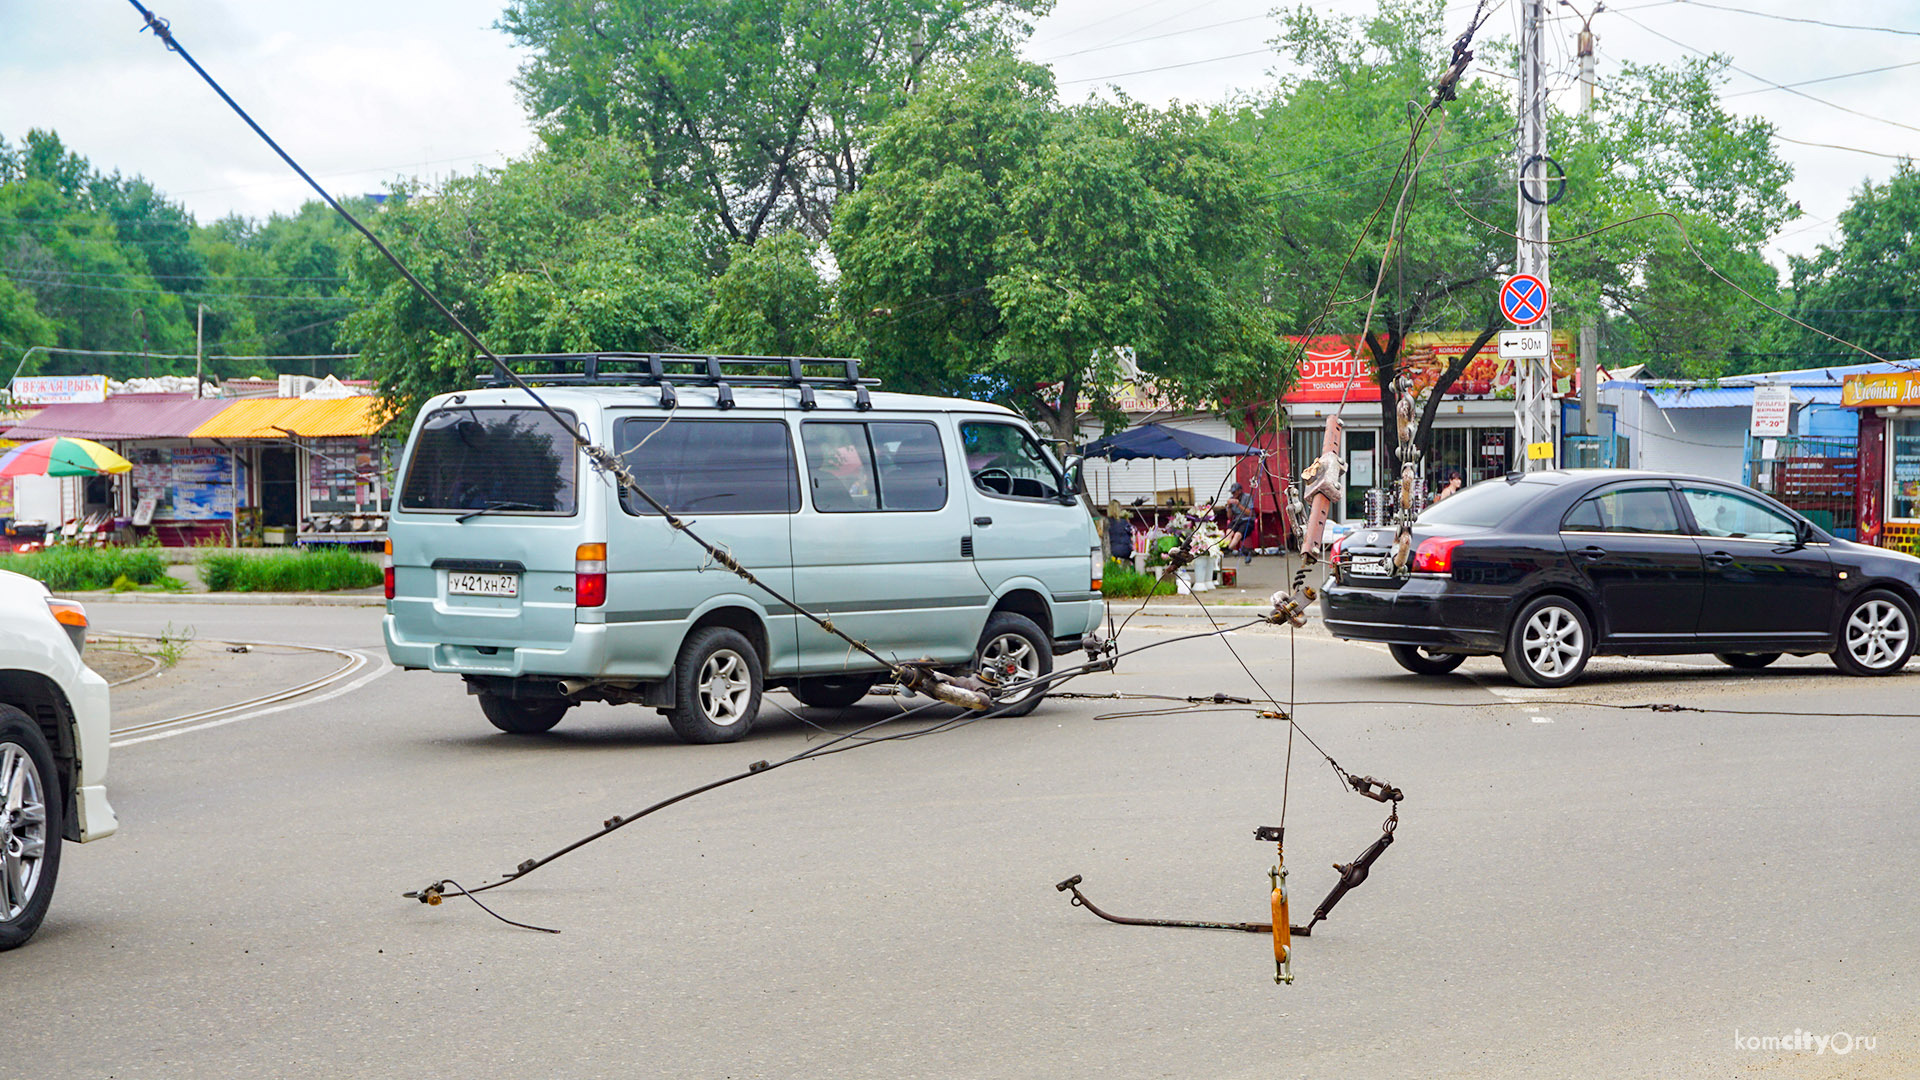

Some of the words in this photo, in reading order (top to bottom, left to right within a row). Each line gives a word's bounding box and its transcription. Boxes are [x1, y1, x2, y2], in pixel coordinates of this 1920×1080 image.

[14, 380, 63, 393] СВЕЖАЯ
[67, 379, 99, 391] РЫБА
[1852, 381, 1897, 400] Хлебный
[1901, 380, 1920, 402] До
[1537, 446, 1542, 455] 1
